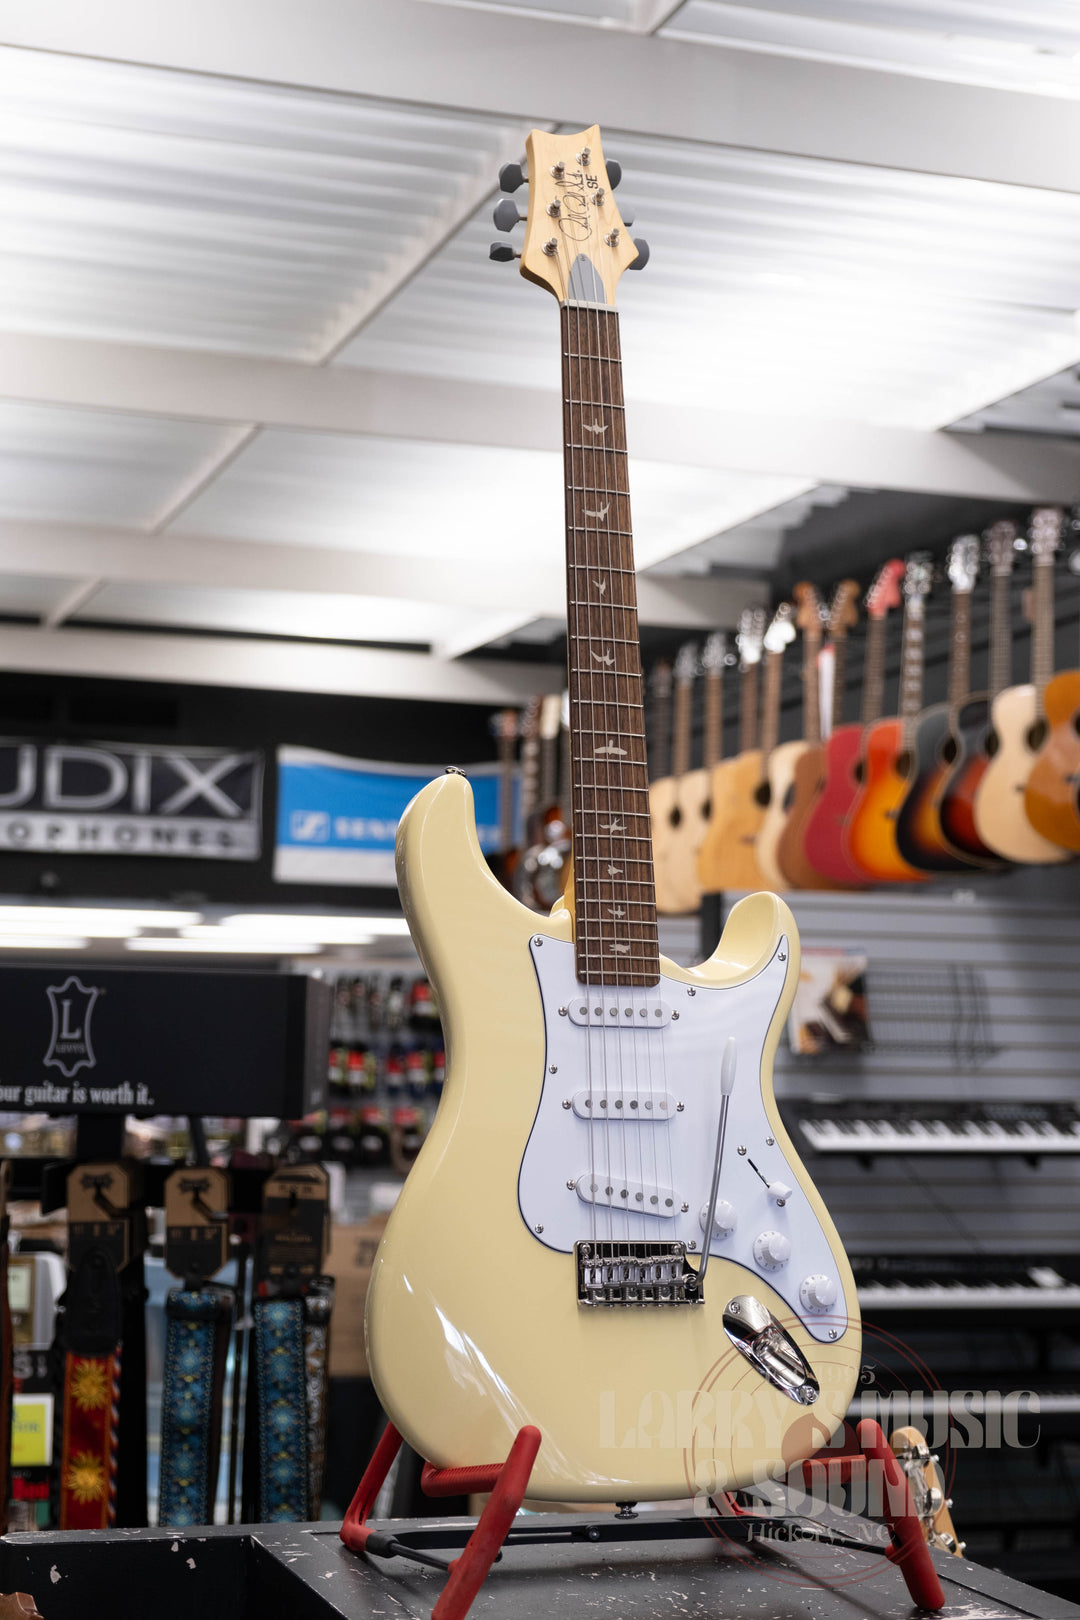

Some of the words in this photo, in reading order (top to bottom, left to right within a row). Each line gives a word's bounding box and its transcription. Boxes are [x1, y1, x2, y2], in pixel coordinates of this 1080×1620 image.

[586, 174, 599, 189] SE
[60, 1000, 82, 1039] L
[24, 1080, 71, 1106] guitar
[72, 1081, 88, 1103] is
[89, 1081, 134, 1105] worth
[136, 1083, 155, 1105] it.
